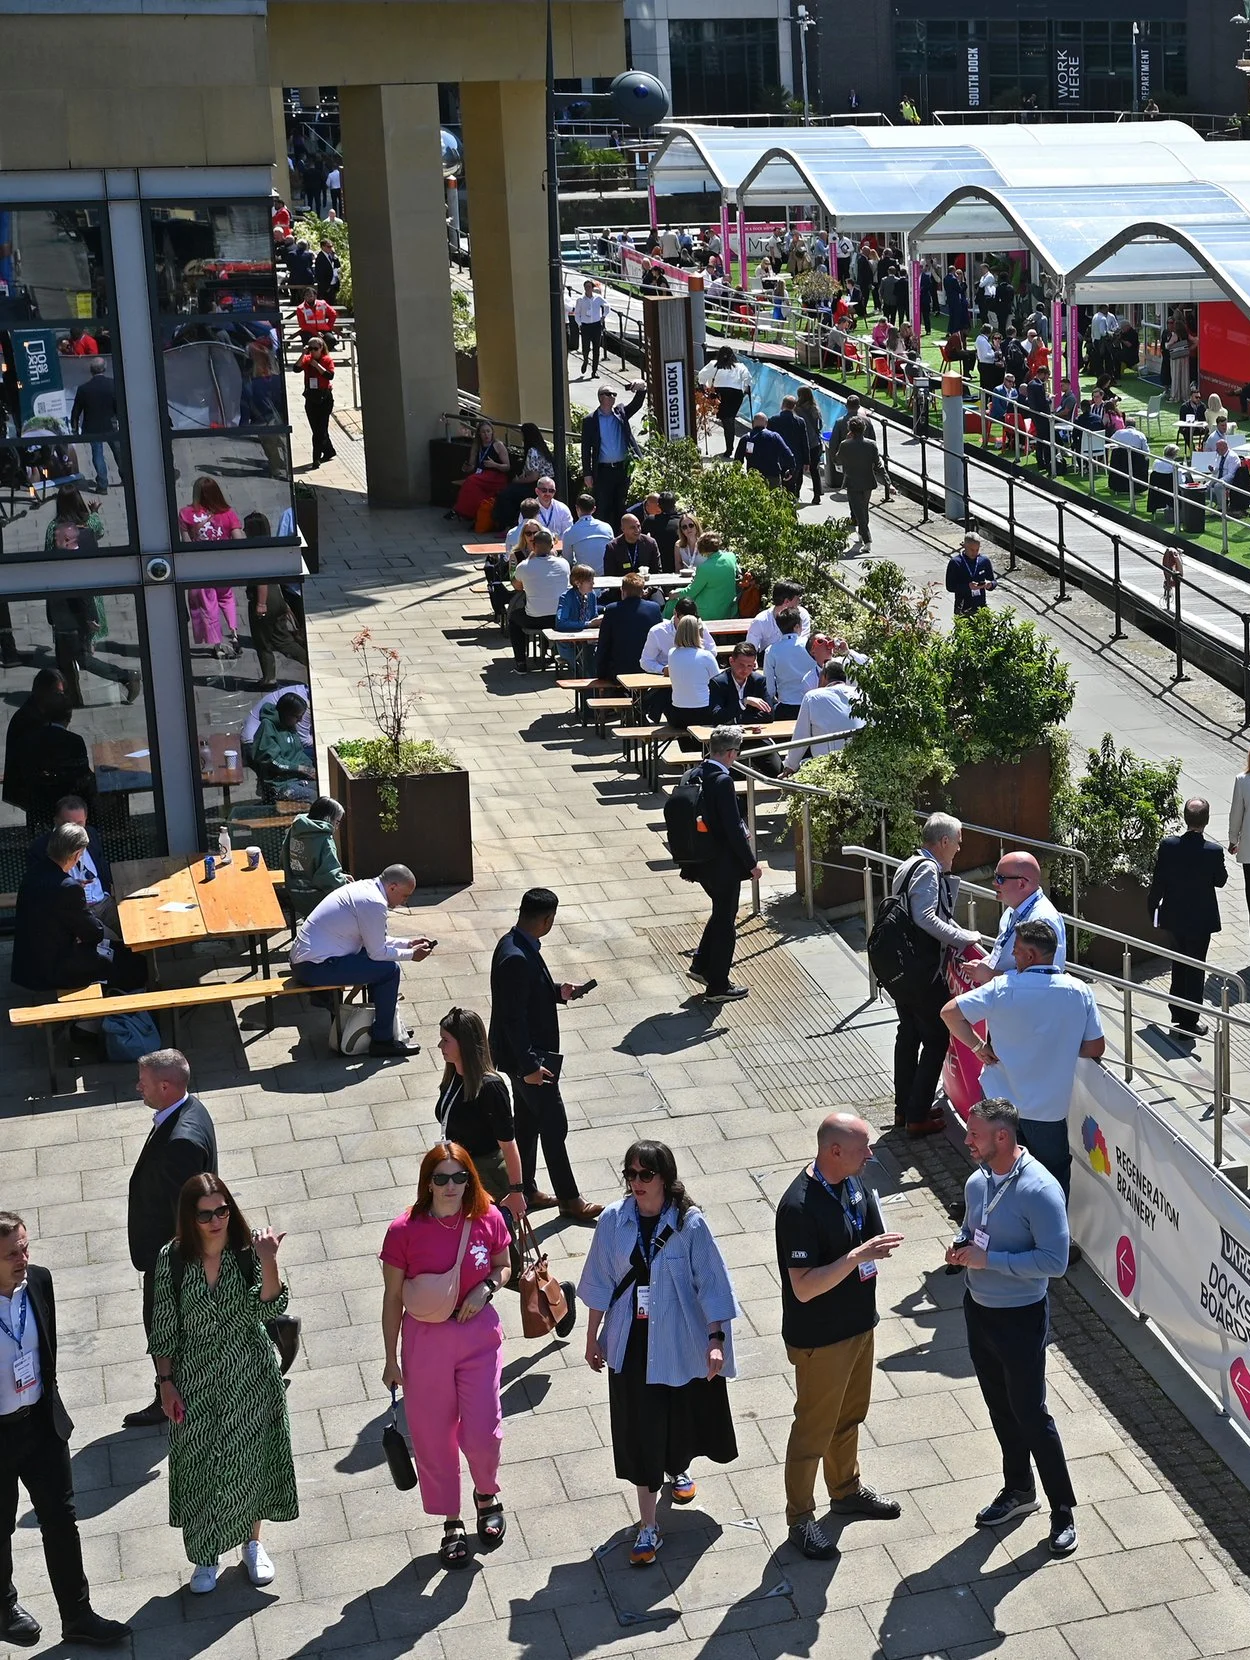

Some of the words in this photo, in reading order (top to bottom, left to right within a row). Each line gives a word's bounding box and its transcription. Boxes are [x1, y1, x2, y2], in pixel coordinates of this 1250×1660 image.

[967, 47, 978, 72] DOCK
[1057, 50, 1068, 99] WORK
[1069, 56, 1080, 99] HERE
[969, 77, 979, 106] SOUTH
[667, 366, 679, 396] DOCK
[669, 397, 680, 430] LEEDS
[1115, 1145, 1180, 1232] REGENERATION
[1116, 1171, 1156, 1232] BRAINERY
